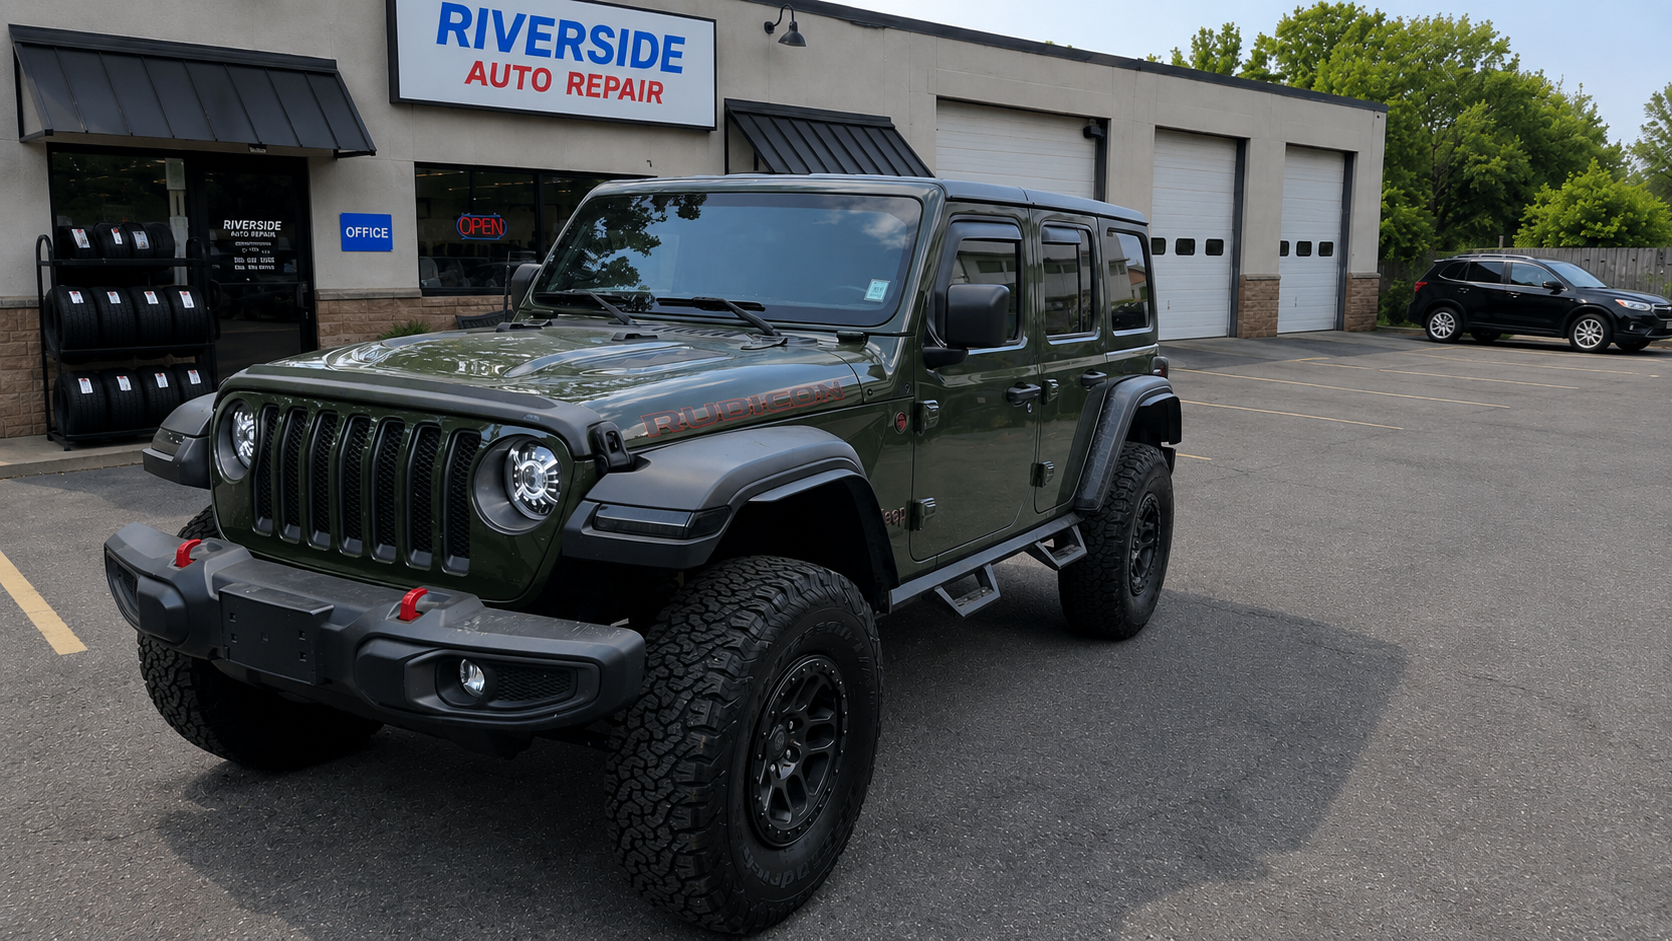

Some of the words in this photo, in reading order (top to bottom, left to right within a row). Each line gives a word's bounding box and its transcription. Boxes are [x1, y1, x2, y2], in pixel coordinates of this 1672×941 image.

[436, 1, 686, 75] RIVERSIDE
[464, 60, 551, 93] AUTO
[566, 71, 664, 105] REPAIR
[223, 219, 282, 231] RIVERSIDE
[345, 226, 389, 239] OFFICE
[459, 216, 503, 235] OPEN
[881, 507, 906, 529] eep
